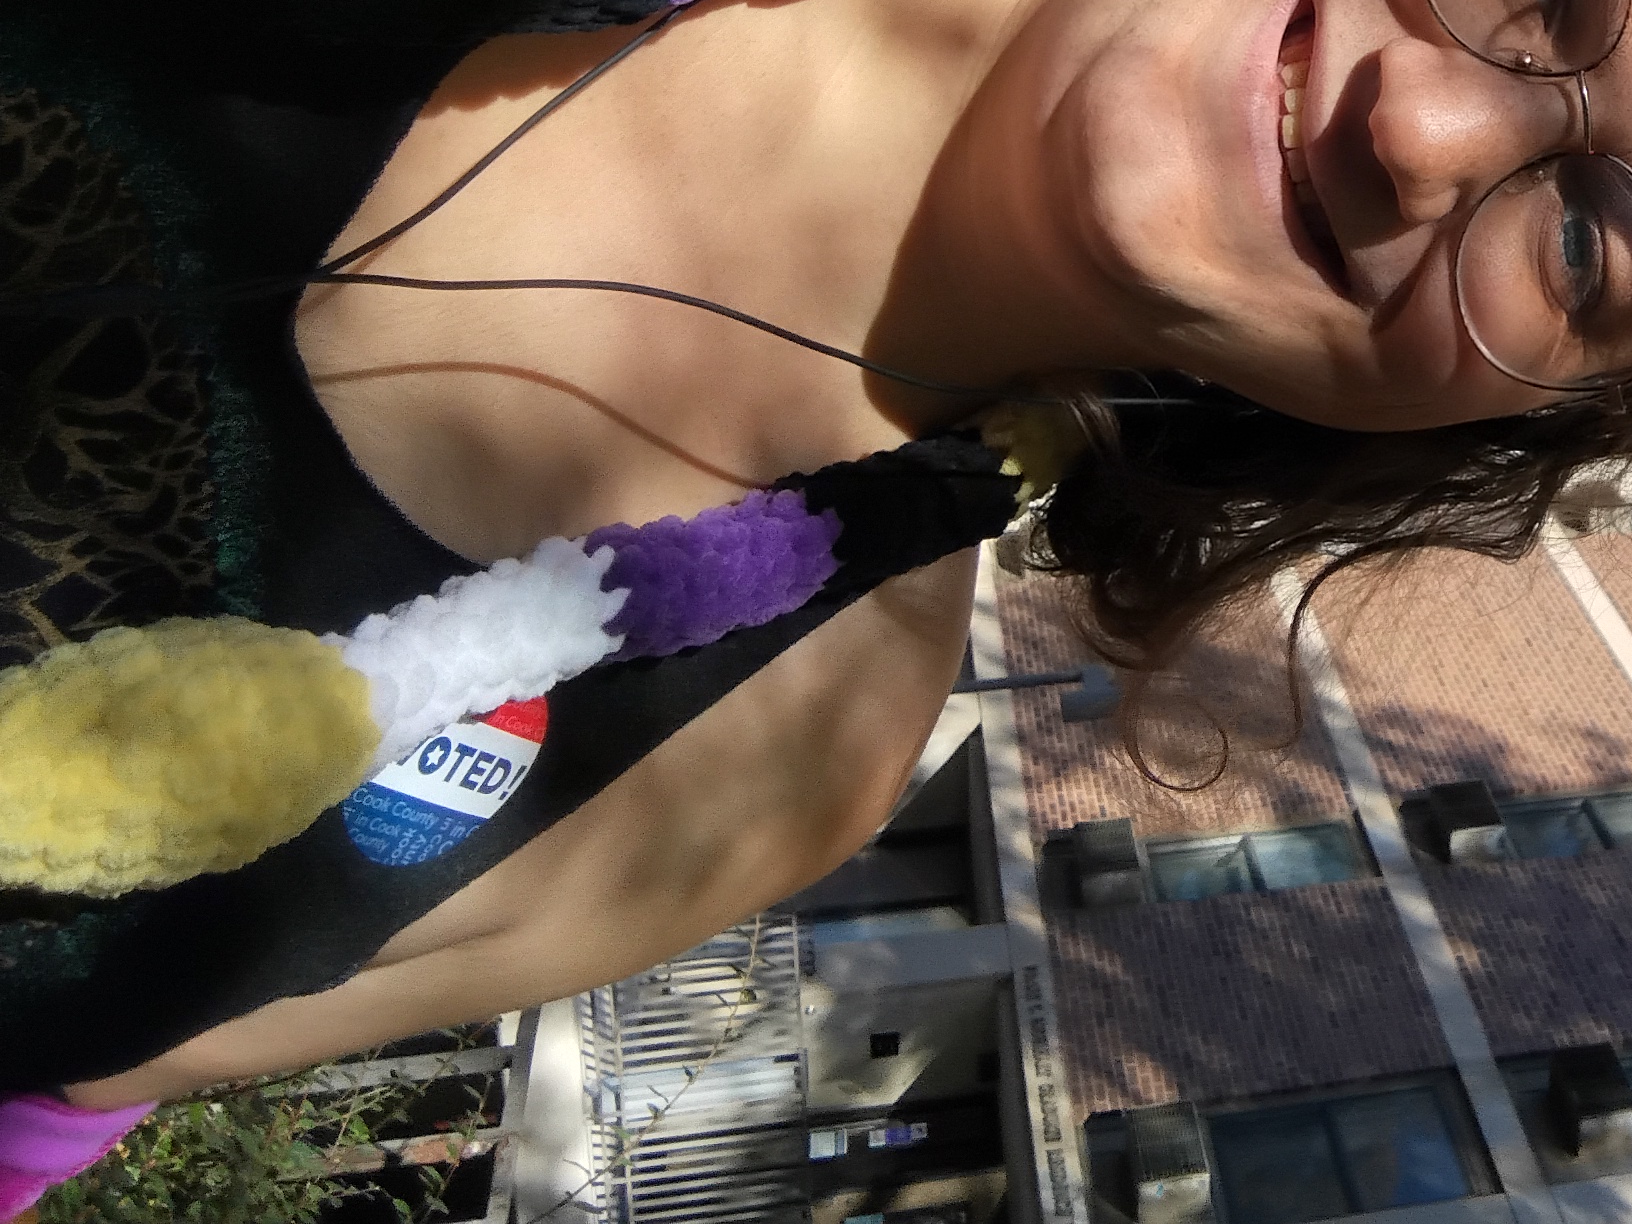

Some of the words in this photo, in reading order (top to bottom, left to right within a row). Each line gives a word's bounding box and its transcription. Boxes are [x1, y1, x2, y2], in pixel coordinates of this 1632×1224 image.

[353, 788, 390, 811] Cook
[393, 801, 439, 830] County
[370, 818, 401, 837] Cook
